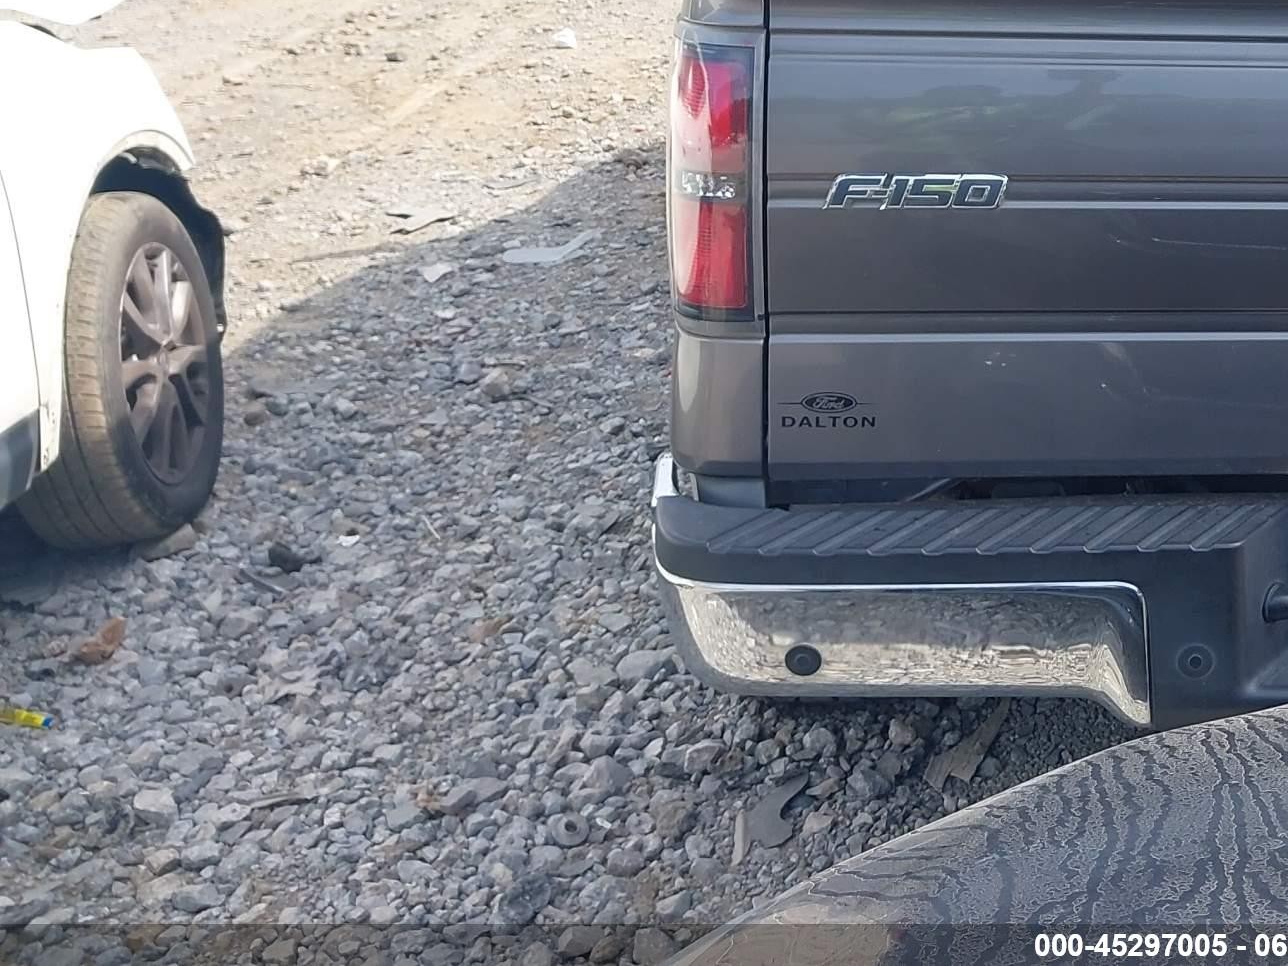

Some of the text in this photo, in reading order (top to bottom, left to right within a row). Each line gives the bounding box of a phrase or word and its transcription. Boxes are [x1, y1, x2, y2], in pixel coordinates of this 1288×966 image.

[823, 173, 1008, 210] F-150
[812, 397, 846, 410] Ford
[781, 416, 876, 428] DALTON
